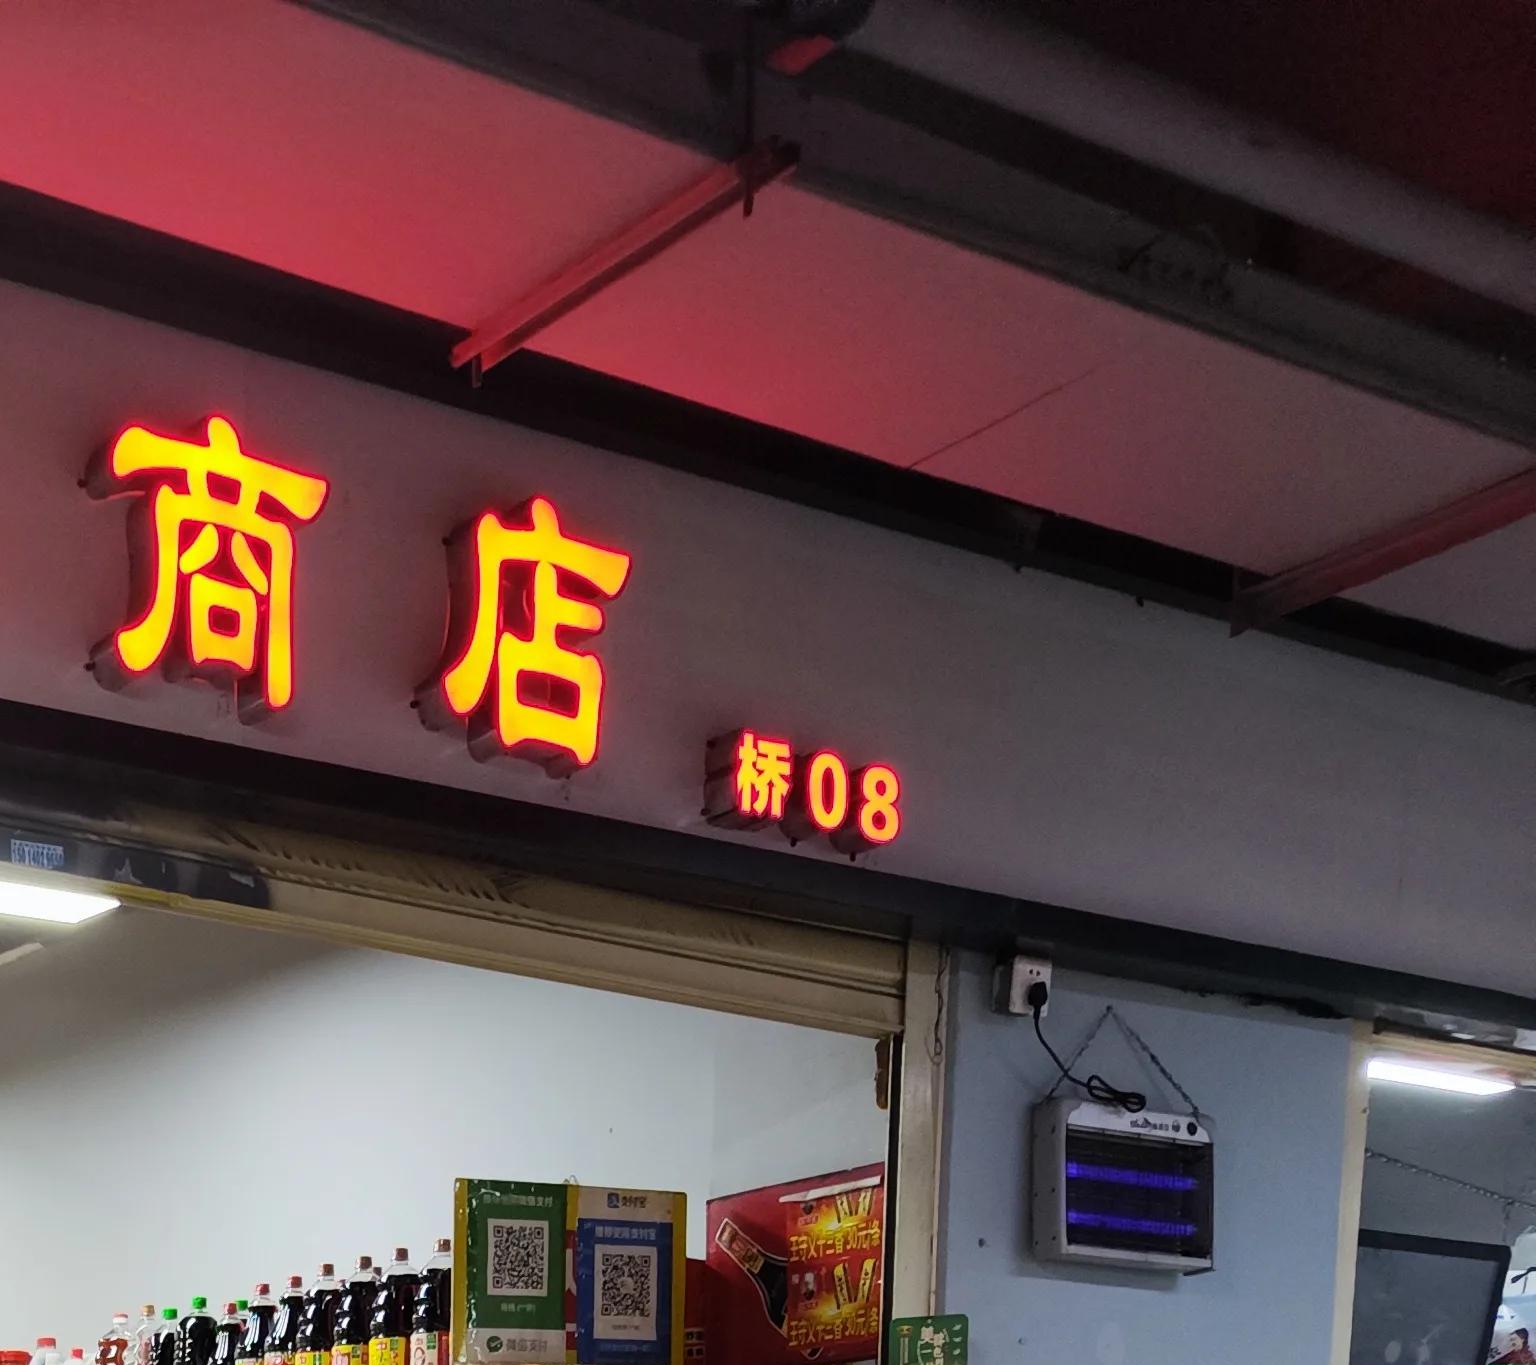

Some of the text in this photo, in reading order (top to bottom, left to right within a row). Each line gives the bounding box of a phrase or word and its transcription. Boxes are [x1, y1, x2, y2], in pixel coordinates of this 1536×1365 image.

[734, 729, 902, 845] 桥08
[506, 1337, 548, 1353] 微信支付
